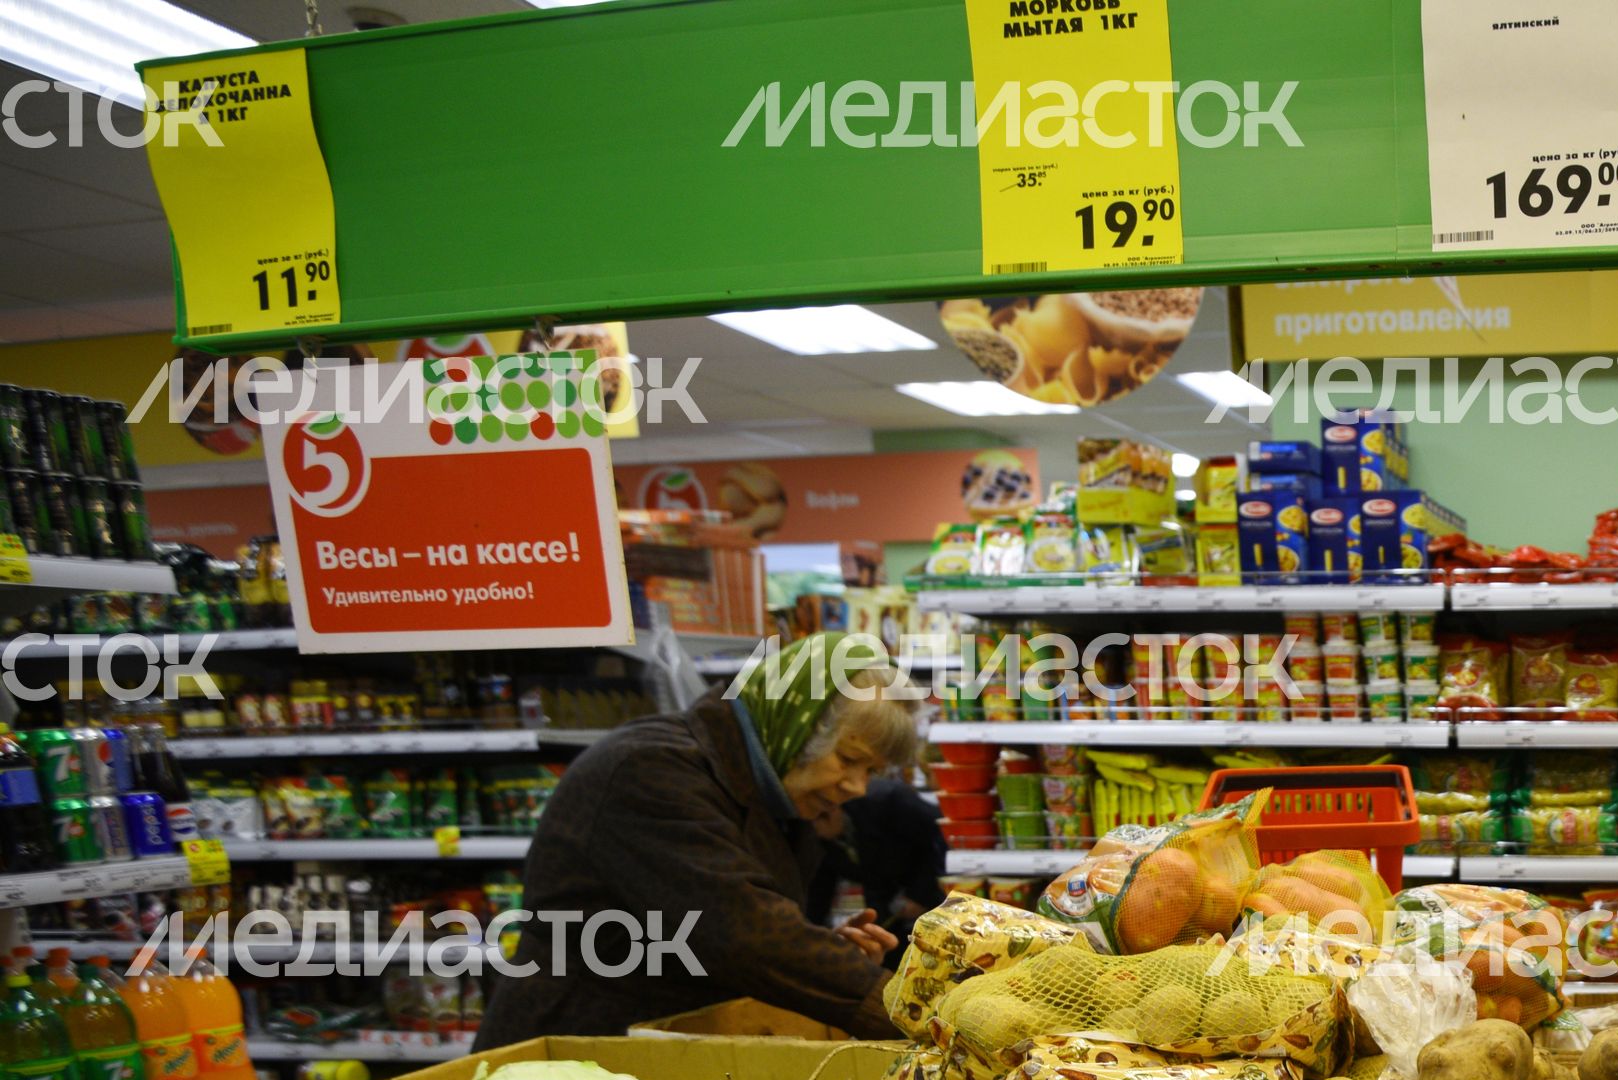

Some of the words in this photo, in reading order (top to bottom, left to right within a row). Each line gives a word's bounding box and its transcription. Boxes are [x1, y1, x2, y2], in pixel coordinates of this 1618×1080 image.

[1003, 17, 1083, 39] МЫТАЯ
[1100, 12, 1138, 30] 1КГ
[178, 70, 260, 94] КАПУСТА
[217, 107, 249, 123] 1КГ
[1532, 154, 1561, 163] цена
[1583, 151, 1595, 159] кг
[1082, 190, 1109, 199] цена
[1112, 189, 1125, 197] за
[1129, 188, 1140, 196] кг
[1143, 185, 1175, 197] (руб.)
[1075, 198, 1175, 250] 19.90
[252, 260, 330, 311] 11.90
[1275, 304, 1511, 343] приготовления
[315, 540, 398, 571] Весы
[427, 543, 468, 567] на
[477, 531, 581, 565] кассе!
[321, 585, 448, 608] Удивительно
[451, 581, 535, 606] удобно!
